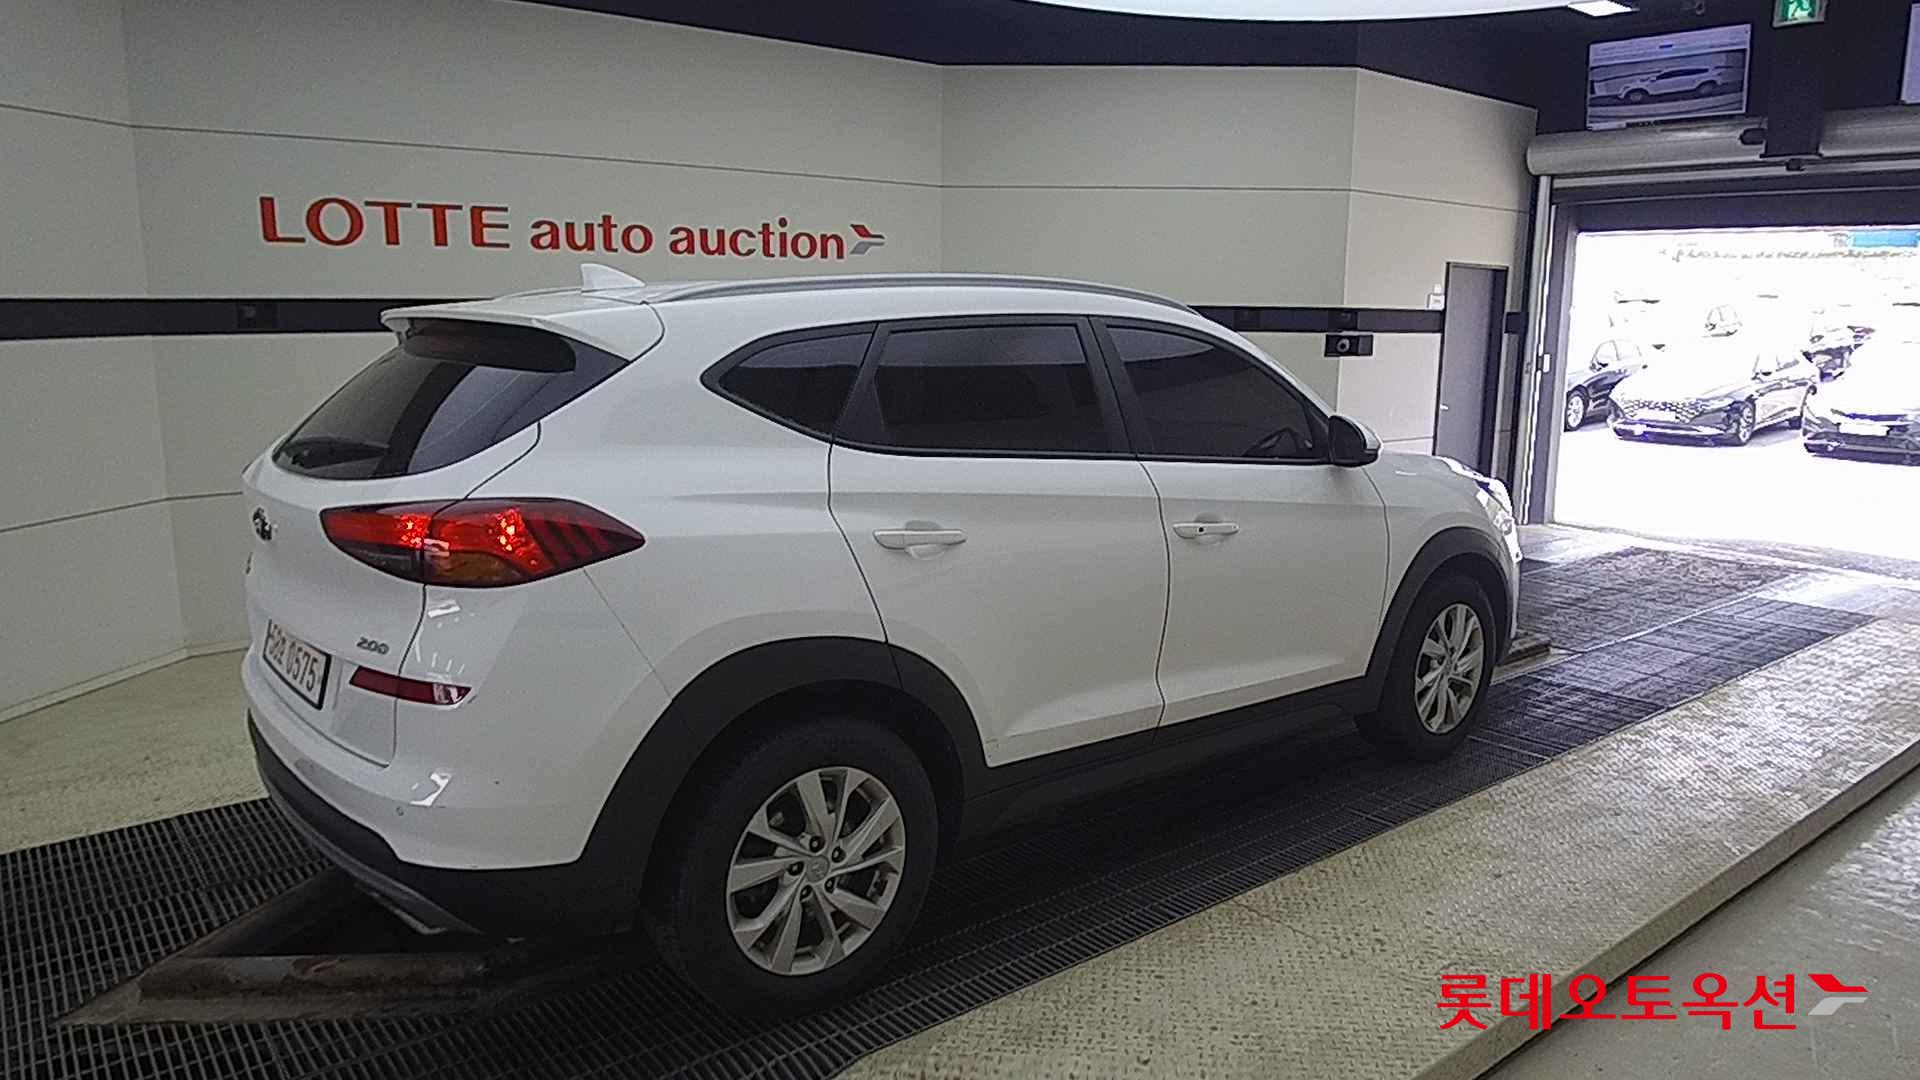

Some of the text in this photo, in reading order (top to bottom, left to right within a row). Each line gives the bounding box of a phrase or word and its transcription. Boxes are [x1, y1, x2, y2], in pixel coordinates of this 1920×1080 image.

[259, 196, 845, 260] LOTTE auto auction
